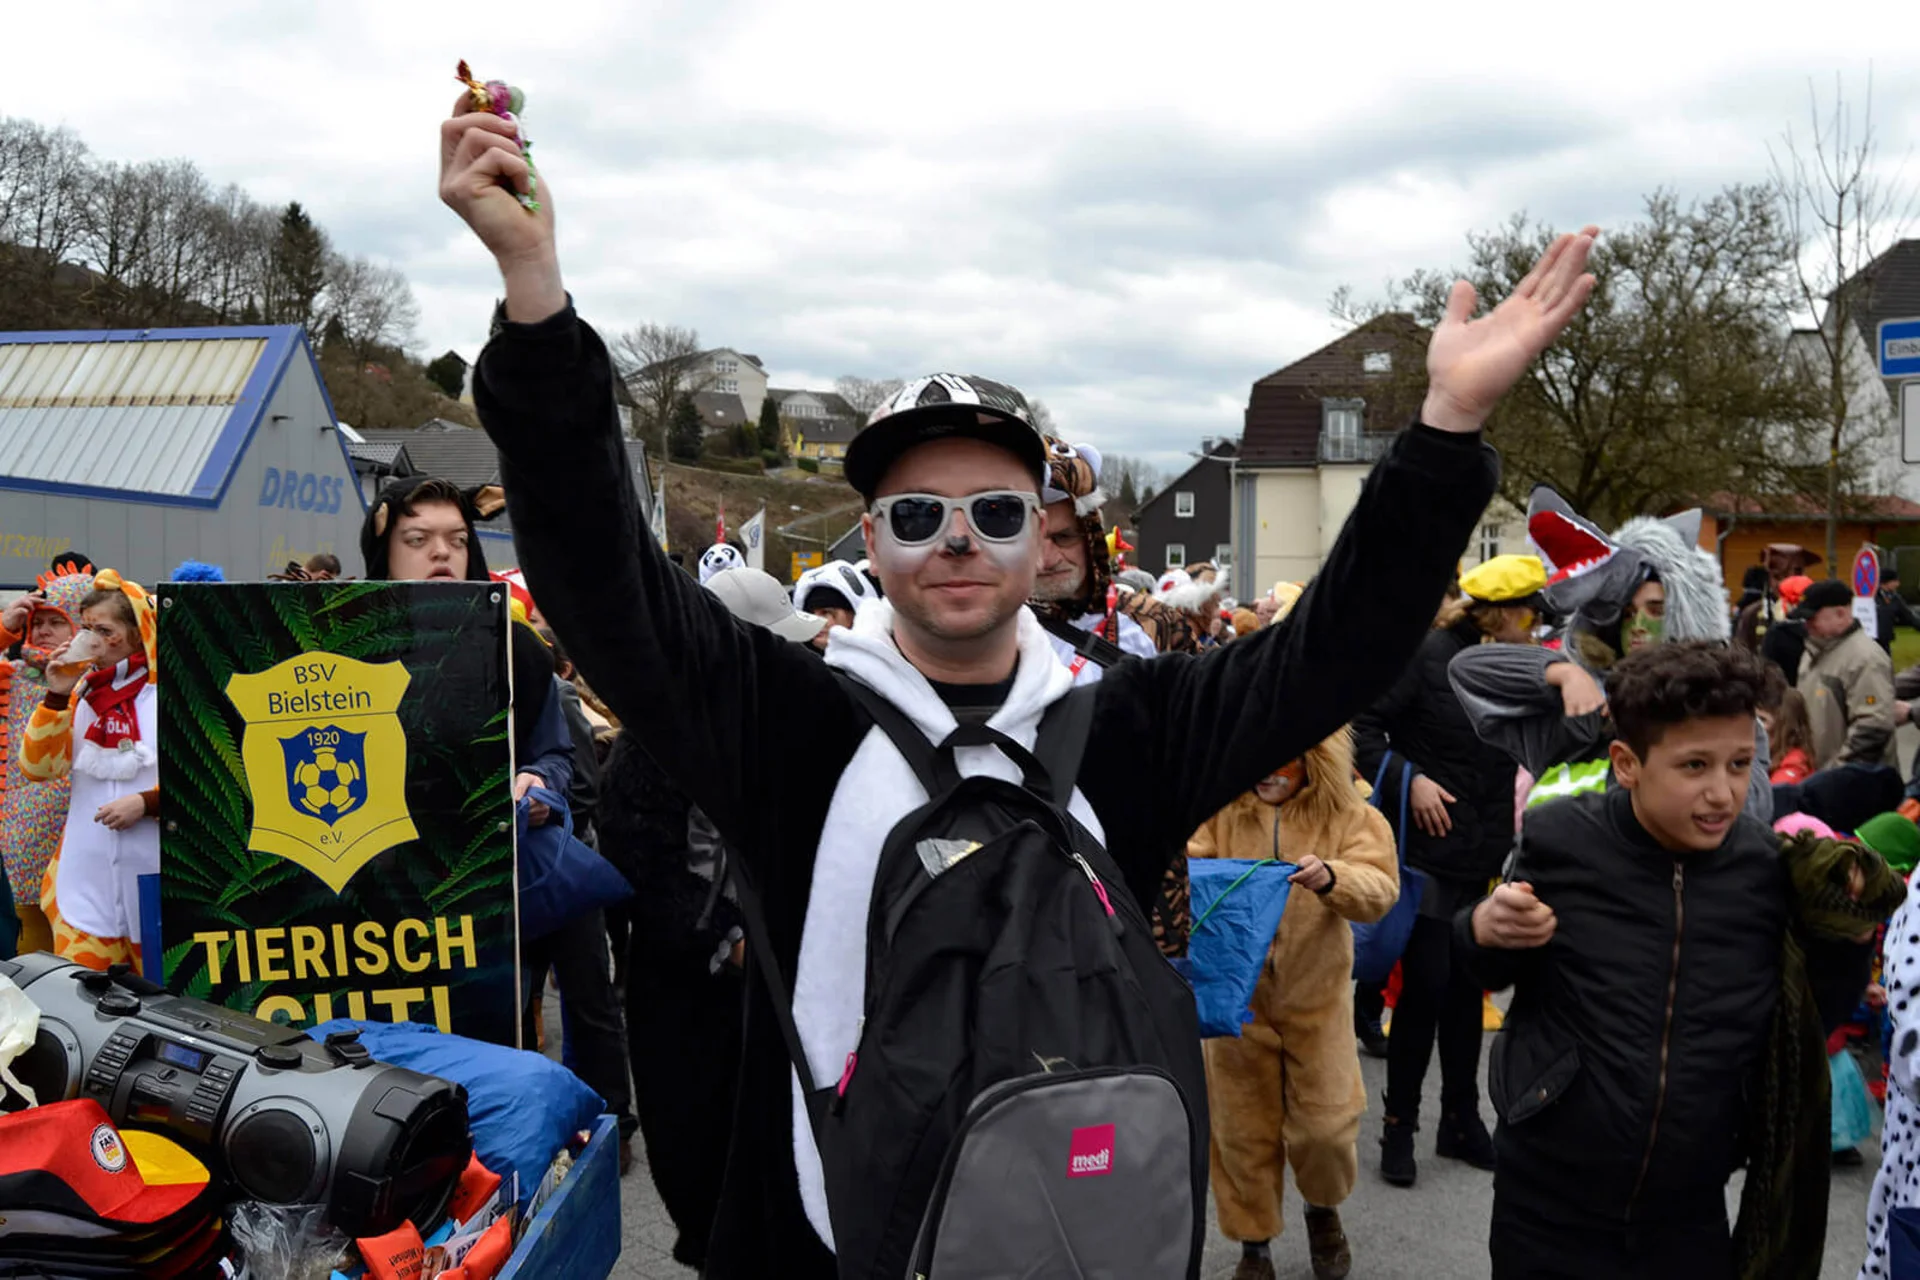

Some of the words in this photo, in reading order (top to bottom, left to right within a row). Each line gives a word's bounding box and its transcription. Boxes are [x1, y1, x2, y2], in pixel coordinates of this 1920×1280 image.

[258, 466, 343, 514] DROSS
[294, 663, 337, 684] BSV
[268, 685, 372, 715] Bielstein
[105, 716, 131, 735] ÖLN
[307, 730, 340, 746] 1920
[319, 830, 345, 845] e.V.
[193, 914, 477, 984] TIERISCH
[98, 1134, 115, 1150] FAN
[1072, 1148, 1109, 1168] medi
